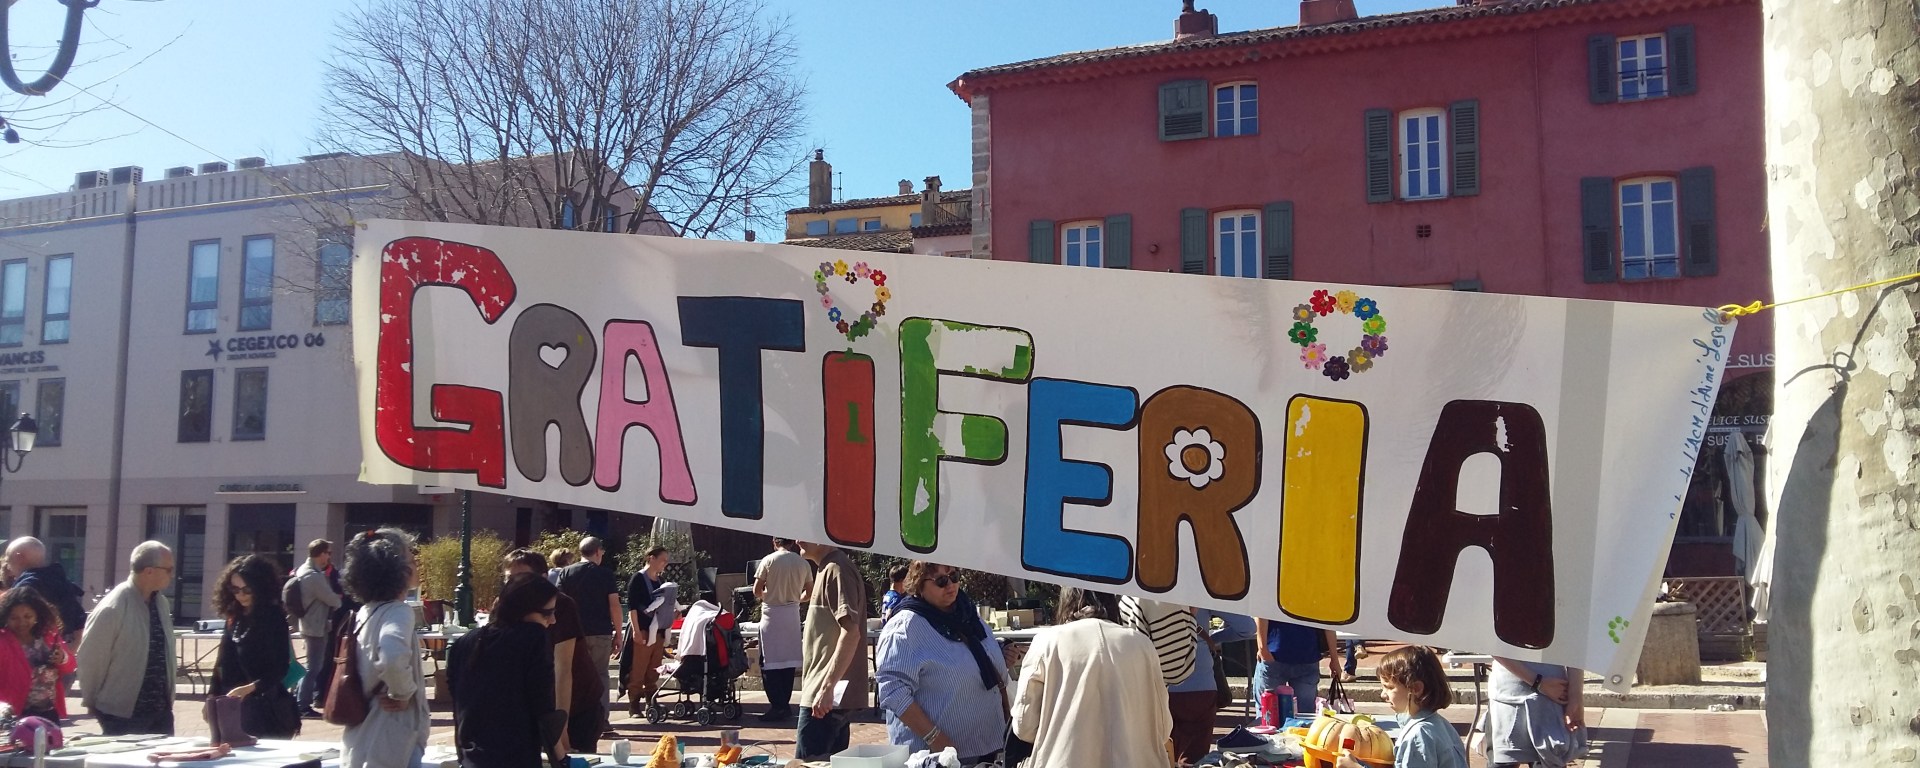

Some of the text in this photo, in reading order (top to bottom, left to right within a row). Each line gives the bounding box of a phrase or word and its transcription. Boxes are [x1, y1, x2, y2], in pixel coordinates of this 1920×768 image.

[226, 332, 325, 352] CEGEXCO 06
[375, 236, 1556, 650] GRATIFERIA
